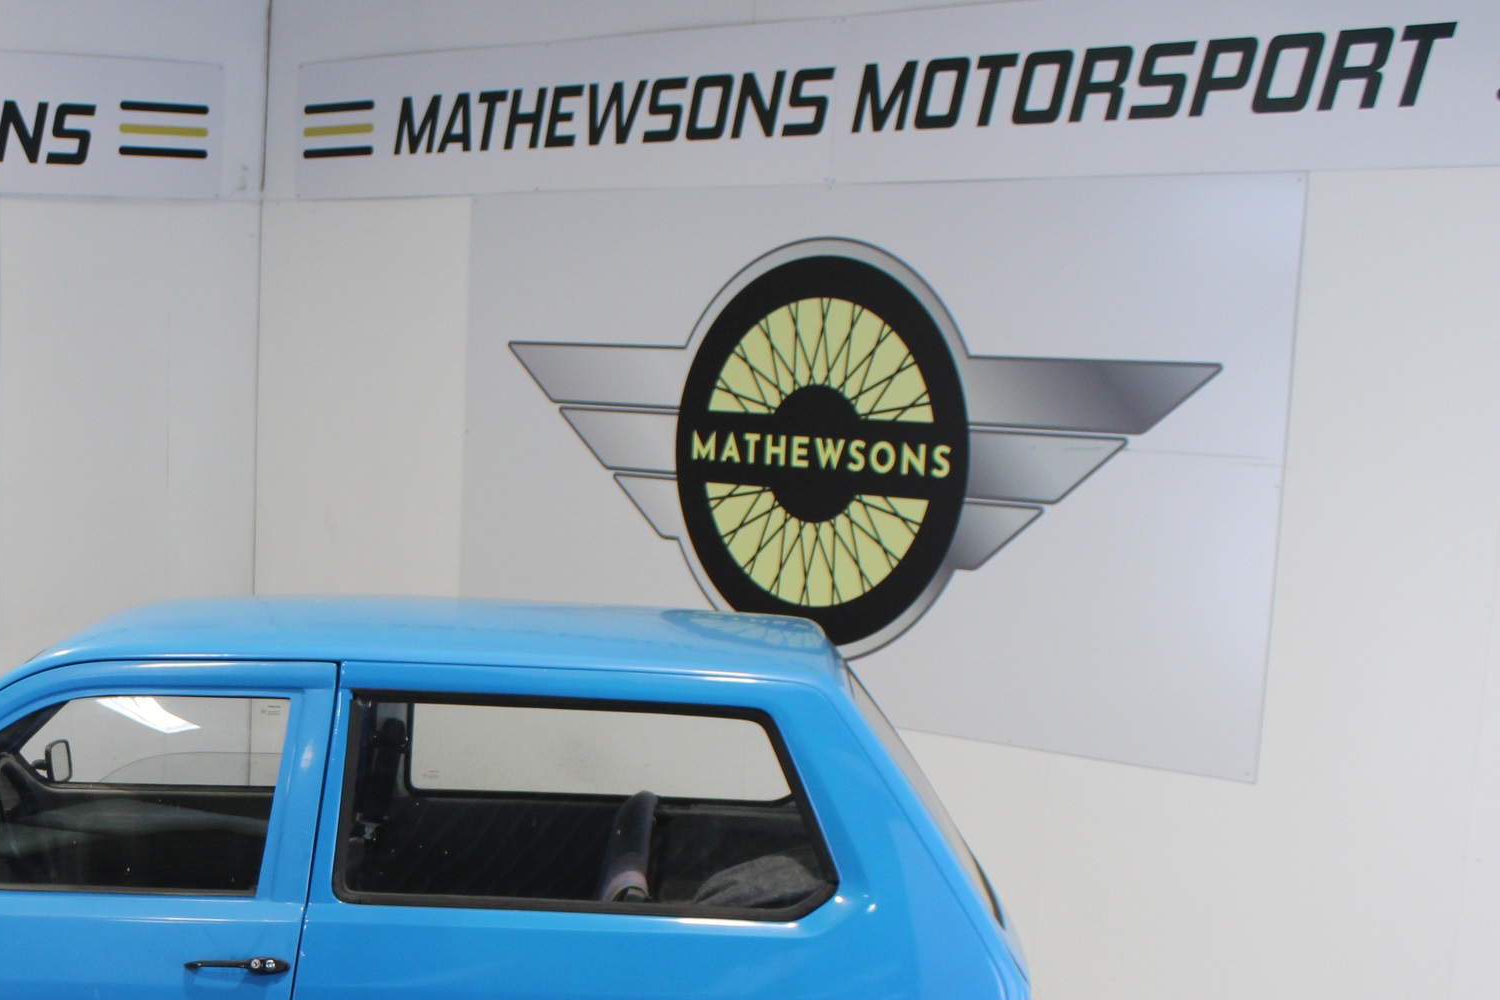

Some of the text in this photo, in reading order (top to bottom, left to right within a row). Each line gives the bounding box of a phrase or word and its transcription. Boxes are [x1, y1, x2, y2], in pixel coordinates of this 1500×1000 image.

[393, 21, 1458, 156] MATHEWSONS MOTORSPORT
[691, 430, 952, 479] MATHEWSONS
